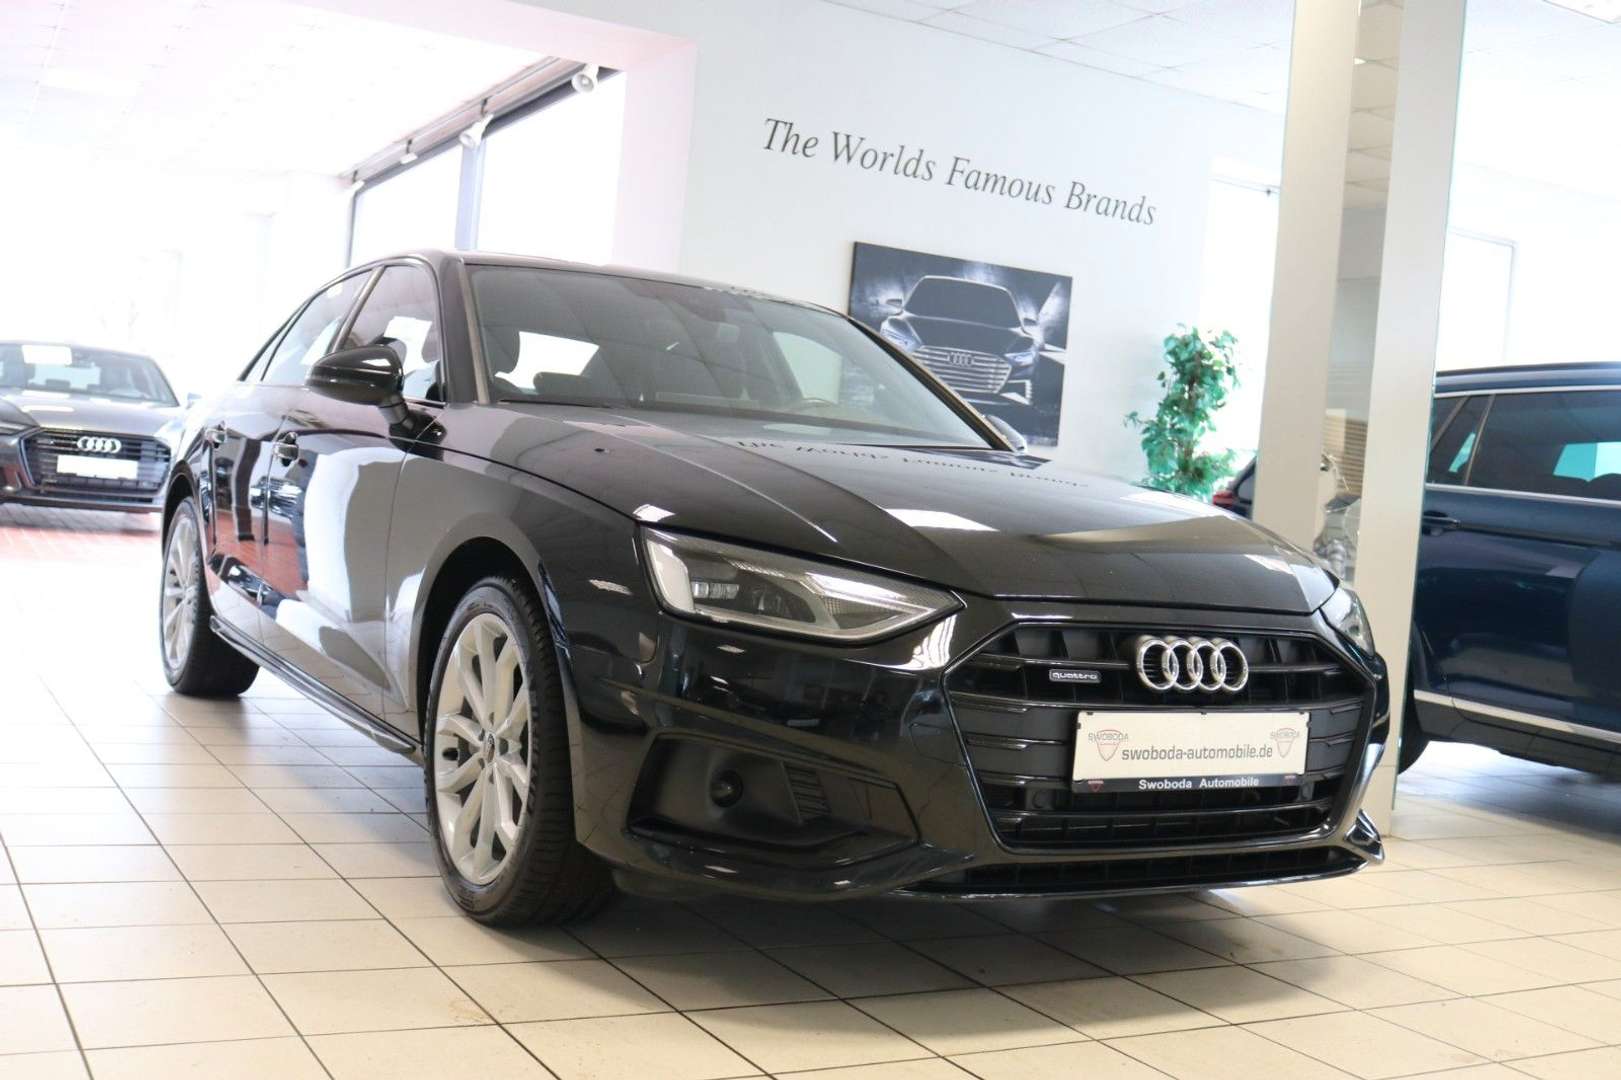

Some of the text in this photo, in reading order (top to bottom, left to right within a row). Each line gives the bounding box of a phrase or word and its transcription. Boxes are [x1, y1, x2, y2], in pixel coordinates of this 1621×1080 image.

[764, 117, 1158, 226] The Worlds Famous Brands
[1052, 672, 1098, 681] quattro
[1121, 744, 1273, 761] swoboda-automobile.de
[1138, 775, 1260, 790] Swoboda Automobile
